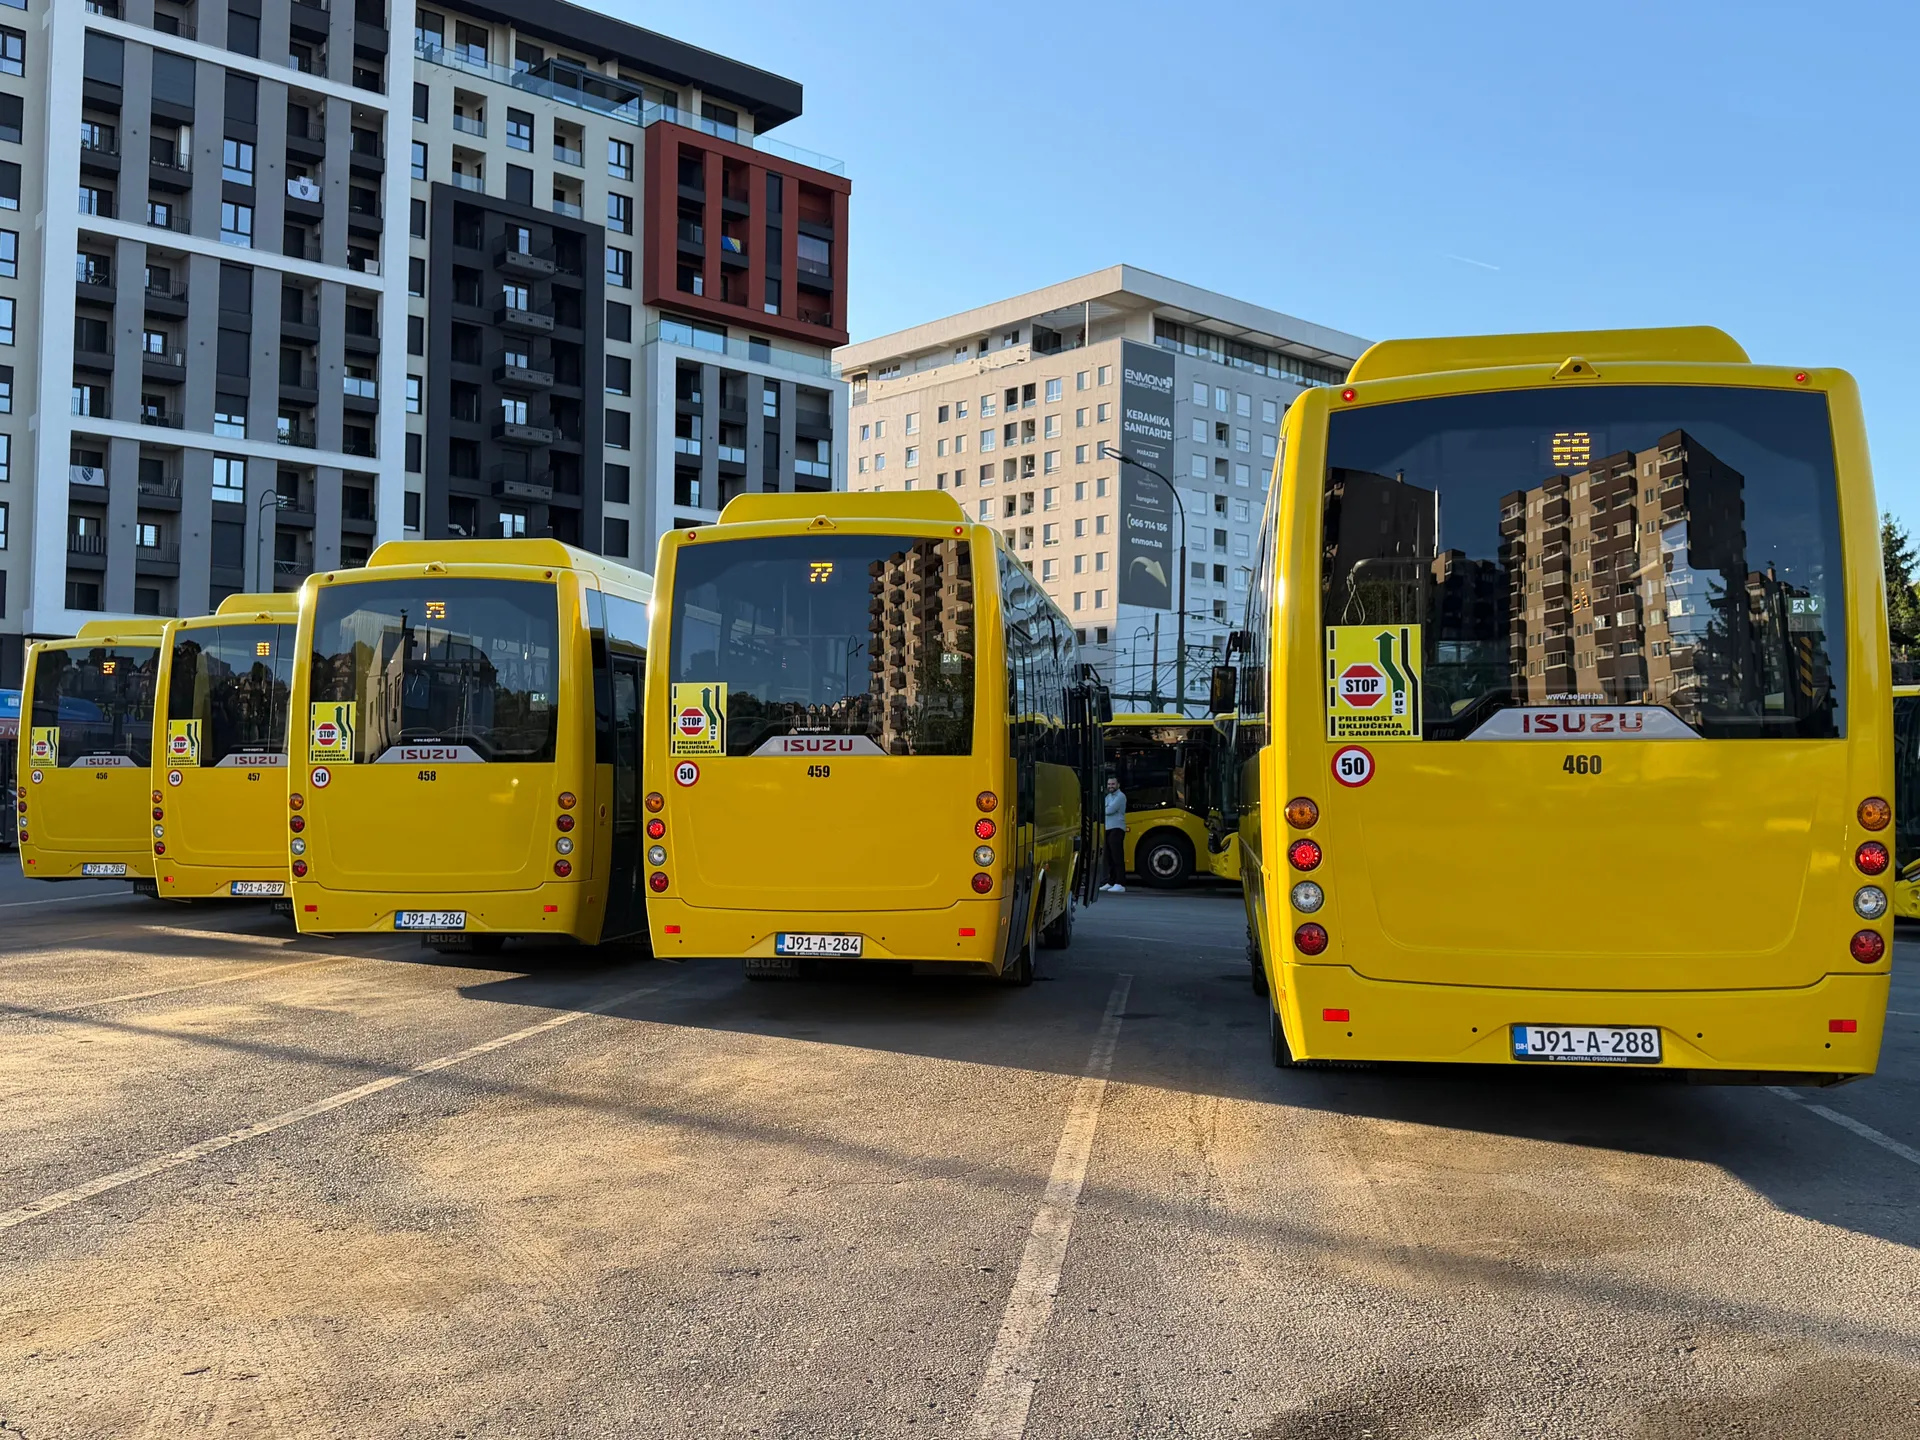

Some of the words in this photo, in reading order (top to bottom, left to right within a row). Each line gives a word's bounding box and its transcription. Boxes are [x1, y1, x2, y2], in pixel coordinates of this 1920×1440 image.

[1125, 368, 1163, 388] ENMON
[1126, 408, 1171, 428] KERAMIKA
[1124, 421, 1172, 440] SANITARIJE
[1130, 518, 1144, 528] 066
[1144, 520, 1156, 530] 714
[1156, 523, 1168, 532] 156
[1131, 537, 1163, 549] enmon.ba
[809, 562, 834, 583] 77
[426, 601, 446, 619] 75
[1345, 679, 1379, 693] STOP
[1394, 692, 1404, 715] BUS
[682, 717, 702, 726] STOP
[1523, 712, 1643, 733] ISUZU
[319, 730, 335, 738] STOP
[784, 739, 853, 752] ISUZU
[234, 756, 278, 765] ISUZU
[401, 749, 458, 760] ISUZU
[85, 758, 121, 766] ISUZU
[1341, 757, 1365, 776] 50
[1562, 755, 1602, 774] 460
[33, 772, 41, 781] 50
[96, 772, 108, 781] 456
[418, 770, 437, 781] 458
[680, 767, 694, 780] 50
[807, 765, 831, 777] 459
[171, 774, 180, 783] 50
[247, 773, 261, 782] 457
[315, 772, 327, 783] 50
[87, 864, 125, 873] J91-A-285
[237, 883, 283, 893] J91-A-287
[403, 913, 463, 925] J91-A-286
[786, 936, 859, 952] J91-A-284
[1531, 1030, 1655, 1054] J91-A-288
